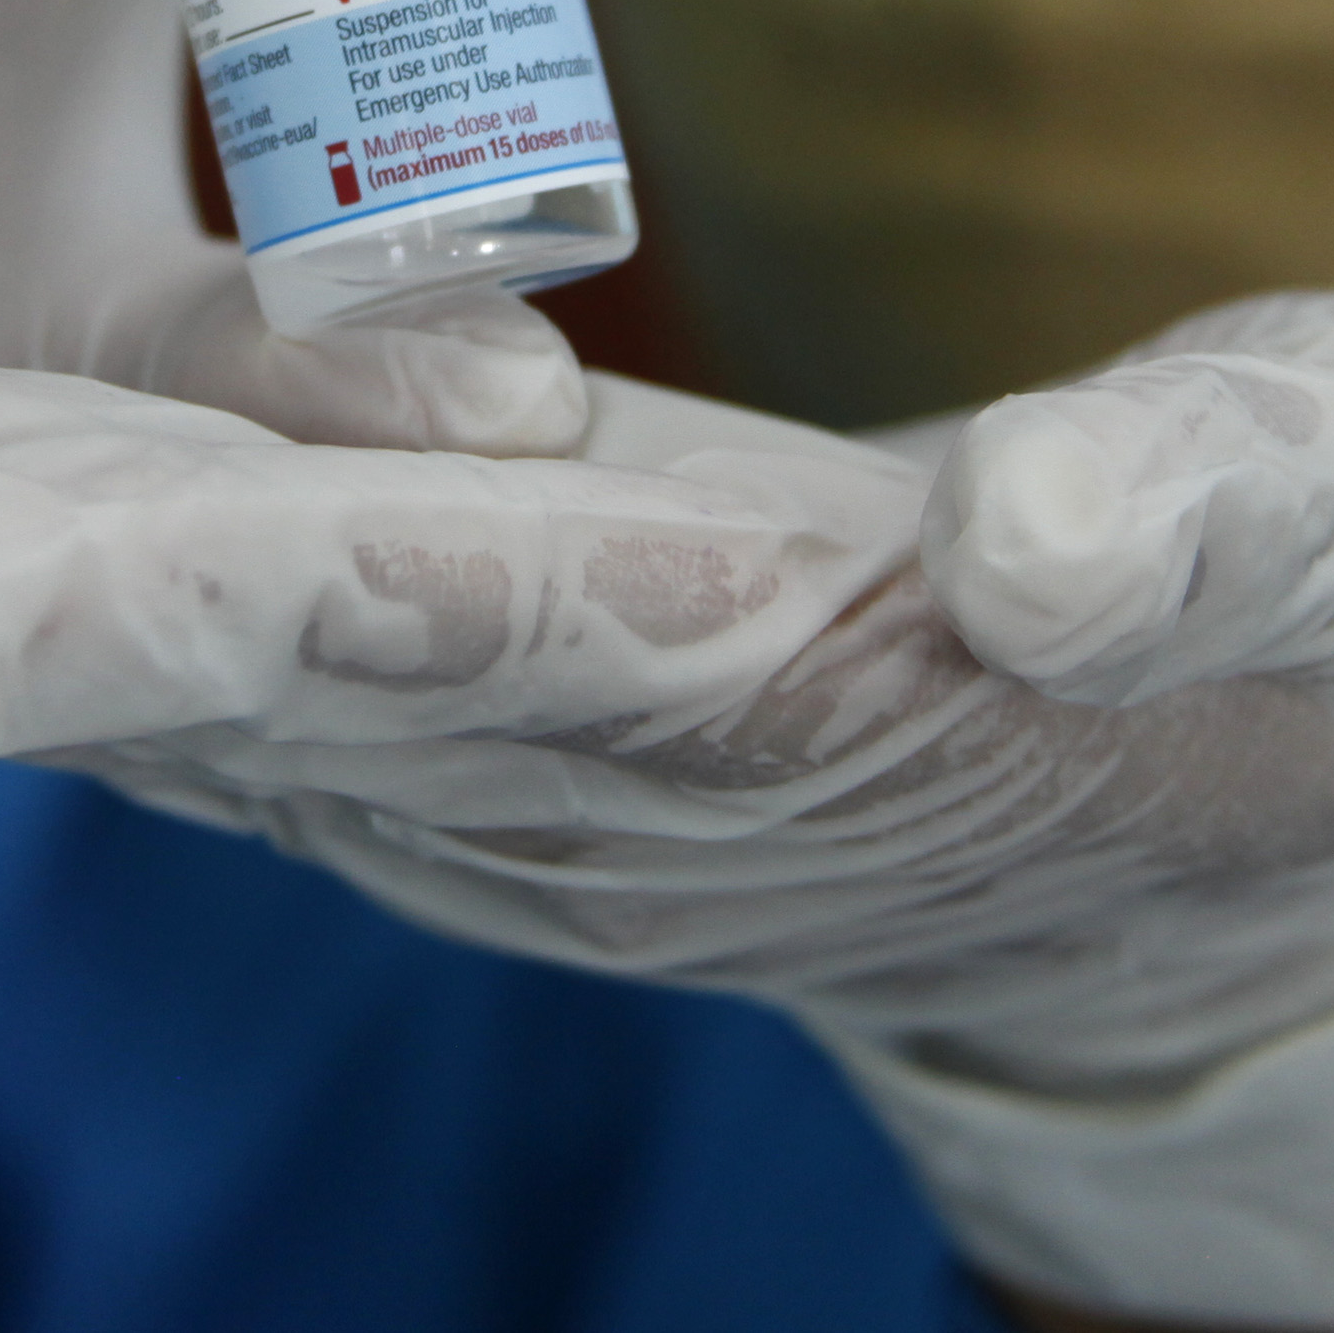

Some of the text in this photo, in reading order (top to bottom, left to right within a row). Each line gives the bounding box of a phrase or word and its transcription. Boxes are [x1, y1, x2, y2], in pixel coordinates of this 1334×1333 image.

[248, 42, 292, 76] Sheet
[342, 3, 558, 67] Intramuscular Injection
[348, 43, 488, 95] For use under
[355, 77, 470, 123] Emergency
[474, 68, 513, 94] Use
[246, 105, 273, 133] visit
[362, 101, 538, 161] Multiple-dose vial
[367, 143, 486, 191] (maximum
[488, 135, 513, 160] 15
[516, 129, 568, 154] doses
[570, 123, 584, 143] of
